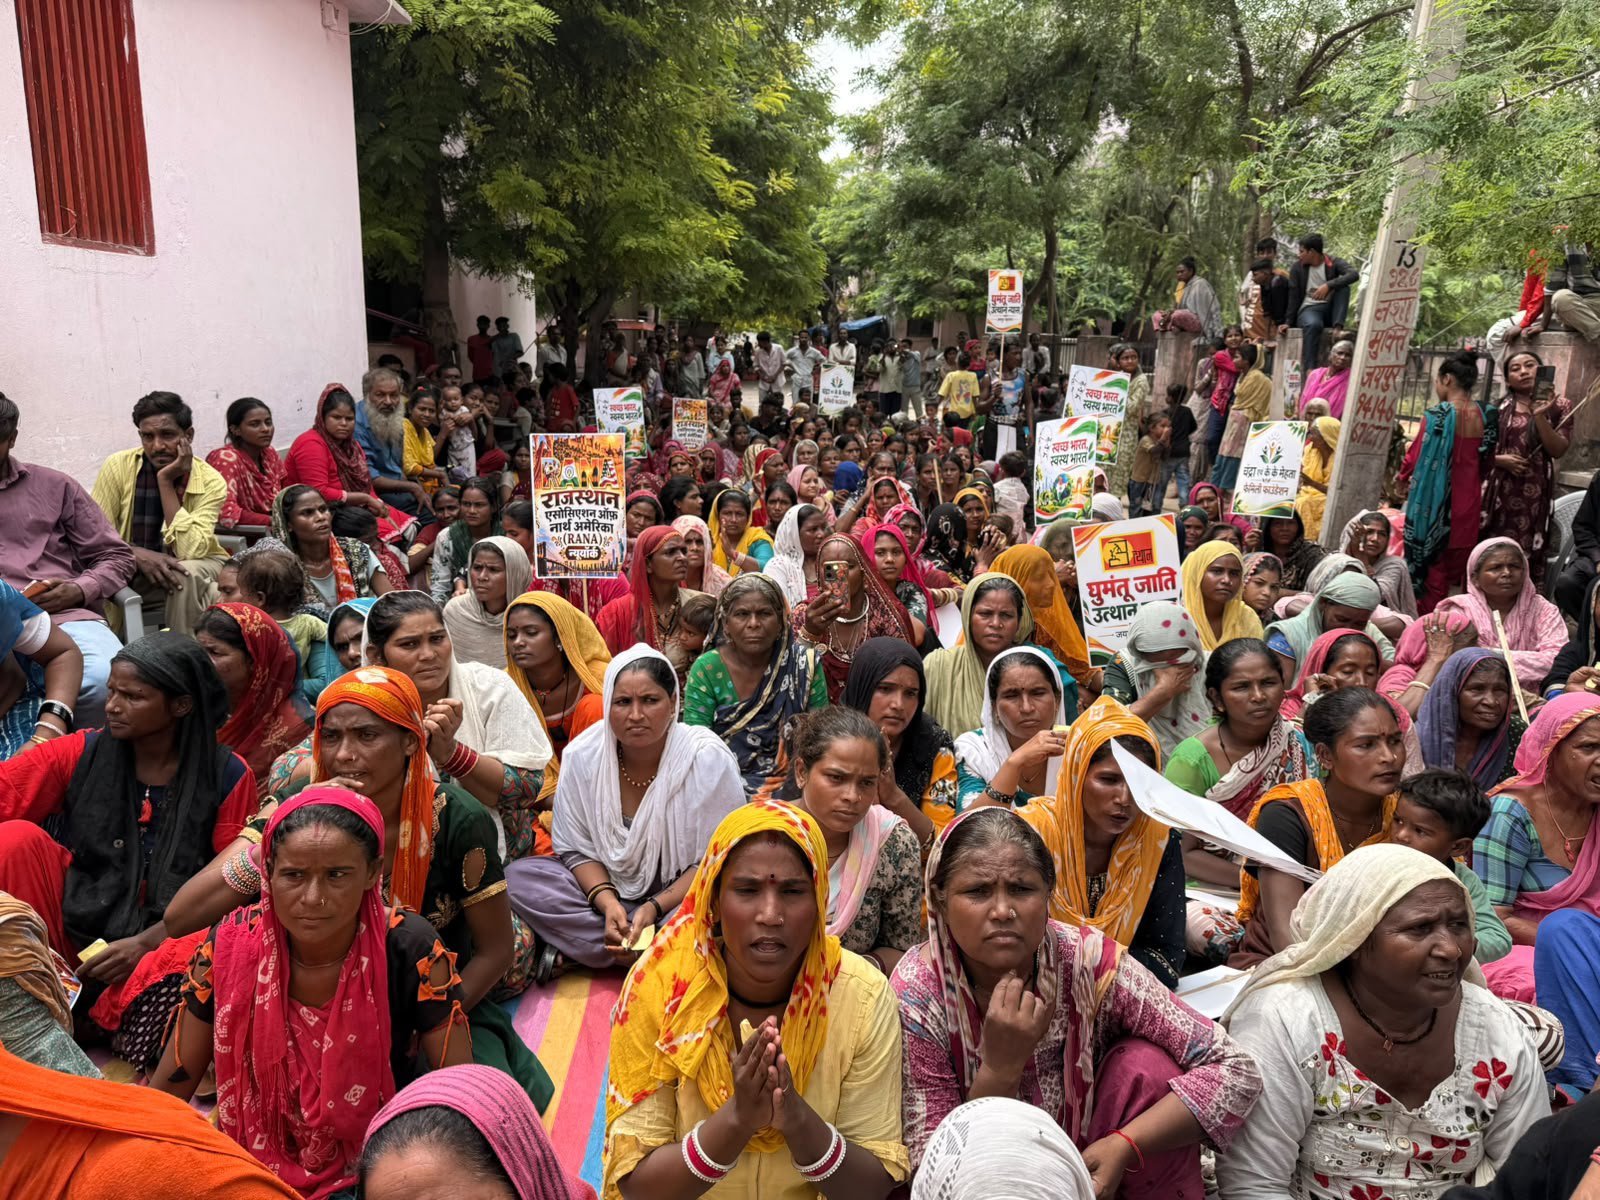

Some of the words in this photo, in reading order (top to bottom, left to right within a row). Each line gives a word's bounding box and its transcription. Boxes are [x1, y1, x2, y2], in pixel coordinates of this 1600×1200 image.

[1102, 402, 1118, 414] भारत
[1051, 441, 1069, 453] स्वच्छ
[1050, 454, 1069, 466] स्वस्थ
[1070, 451, 1088, 464] भारत
[541, 457, 620, 490] RANA
[541, 490, 620, 510] राजस्थान
[545, 507, 596, 522] एसोसिएशन
[550, 519, 572, 533] नार्थ
[574, 518, 614, 534] अमेरिका
[563, 533, 602, 546] (RANA)
[1086, 575, 1136, 606] घुमंतू
[1134, 566, 1177, 594] जाति
[1092, 603, 1138, 624] उत्थान
